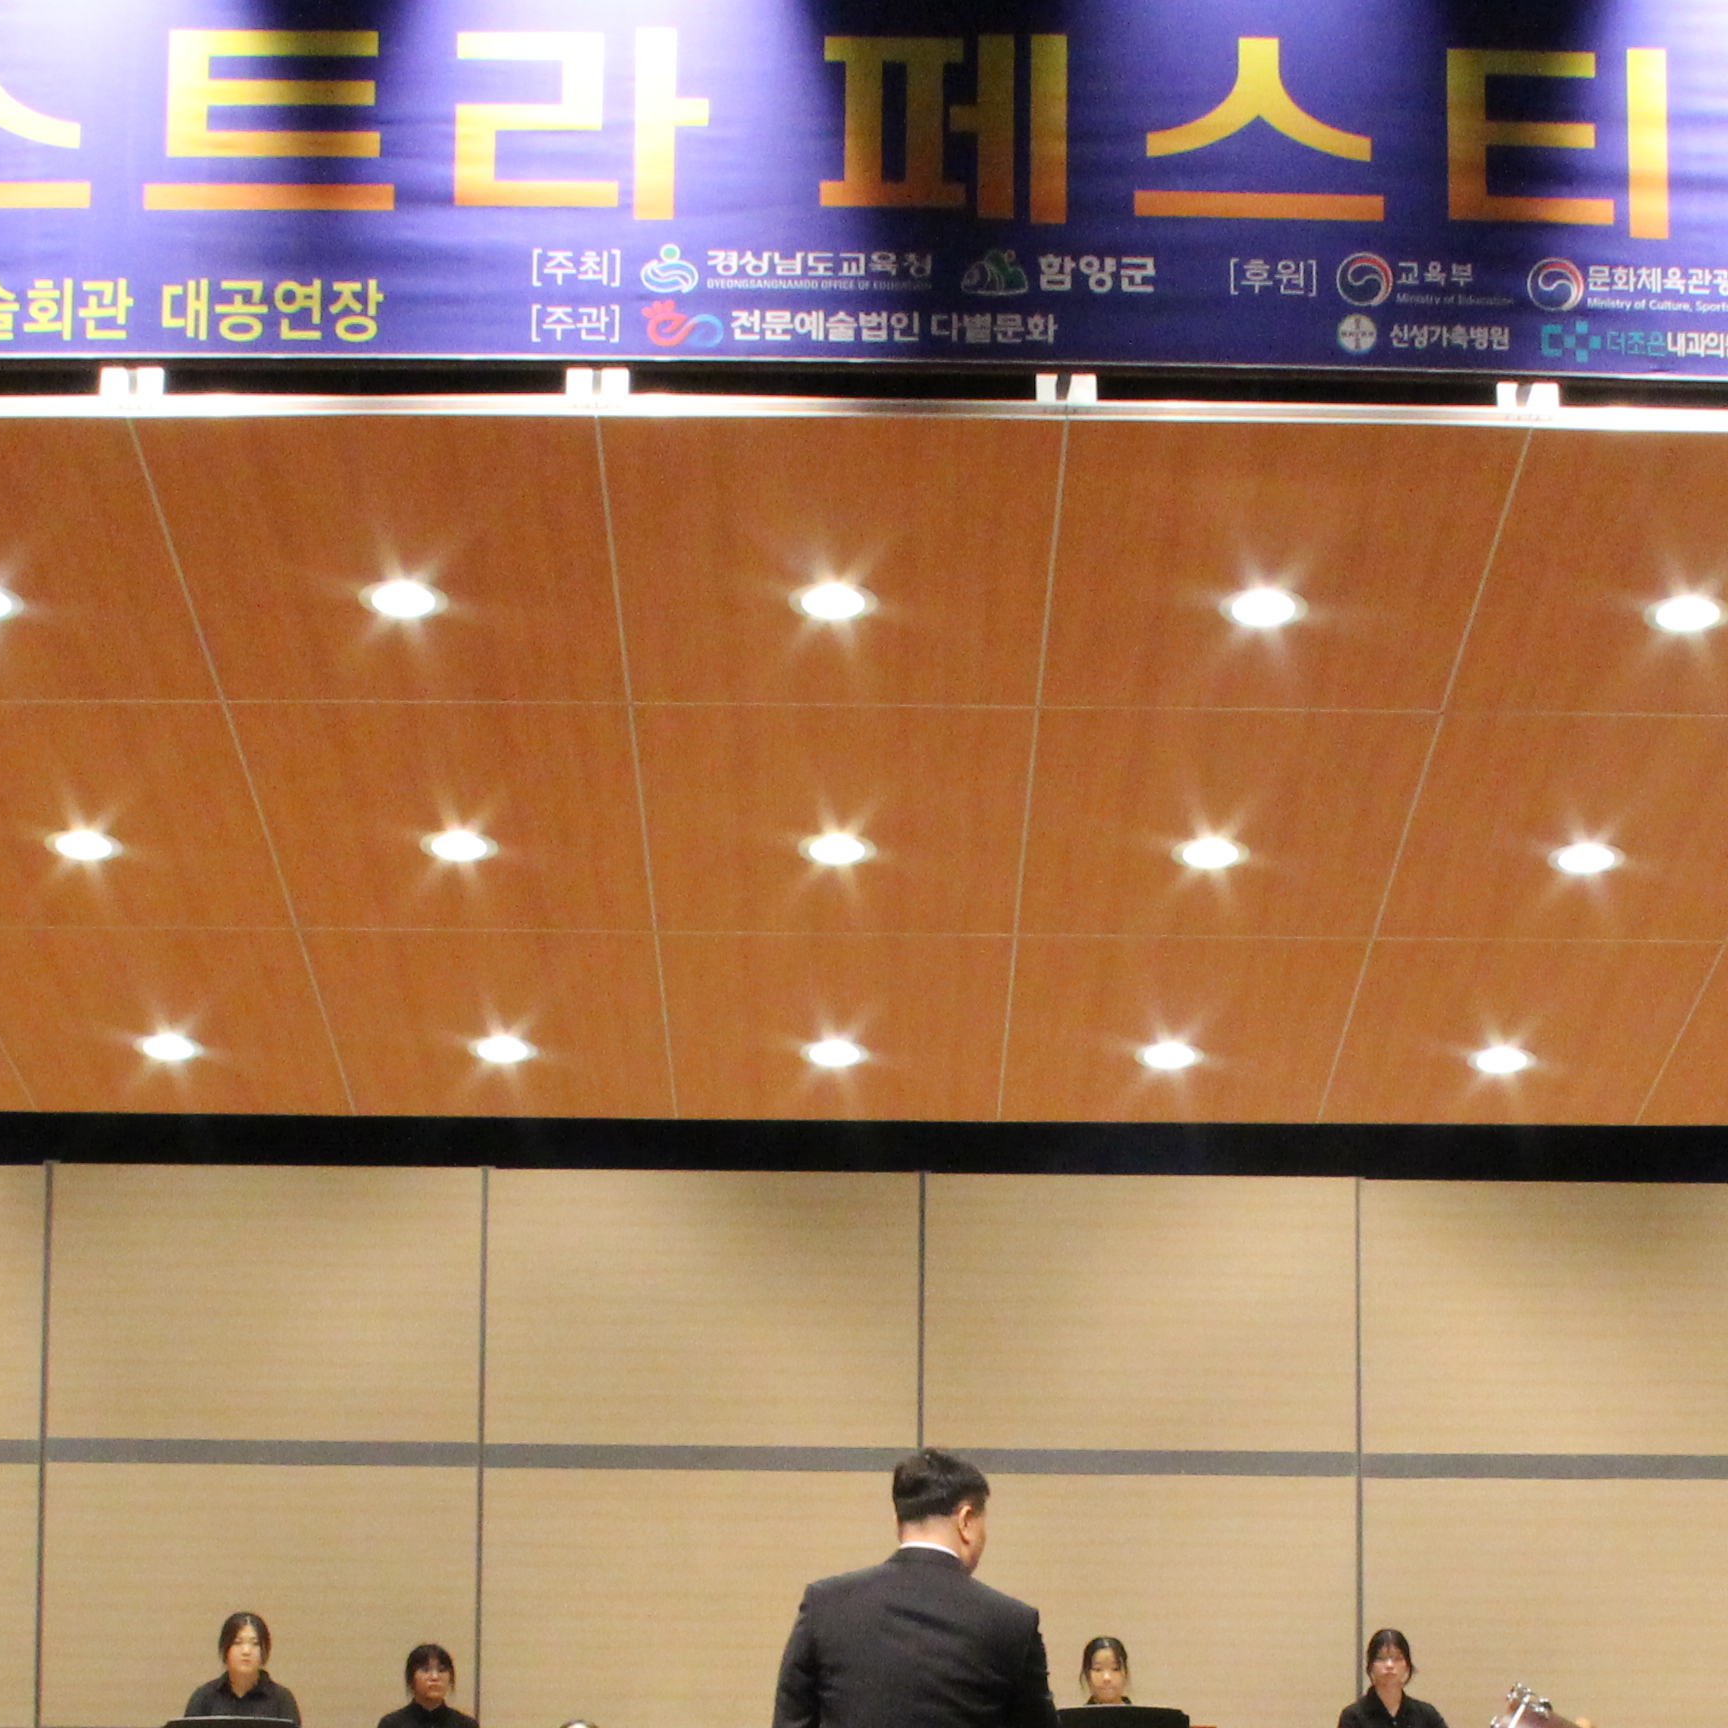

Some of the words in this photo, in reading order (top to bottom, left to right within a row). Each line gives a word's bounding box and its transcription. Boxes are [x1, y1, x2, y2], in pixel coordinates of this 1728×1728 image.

[532, 248, 621, 287] [주최]
[707, 250, 933, 278] 경상남도교육청
[1038, 254, 1157, 294] 함양군
[1230, 258, 1317, 297] [후원]
[1397, 261, 1473, 287] 교육부
[161, 279, 384, 343] 대공연장
[532, 304, 620, 342] [주관]
[731, 309, 920, 342] 전문예술법인
[1587, 296, 1631, 312] Ministry
[1634, 297, 1646, 311] of
[1649, 298, 1692, 314] Culture,
